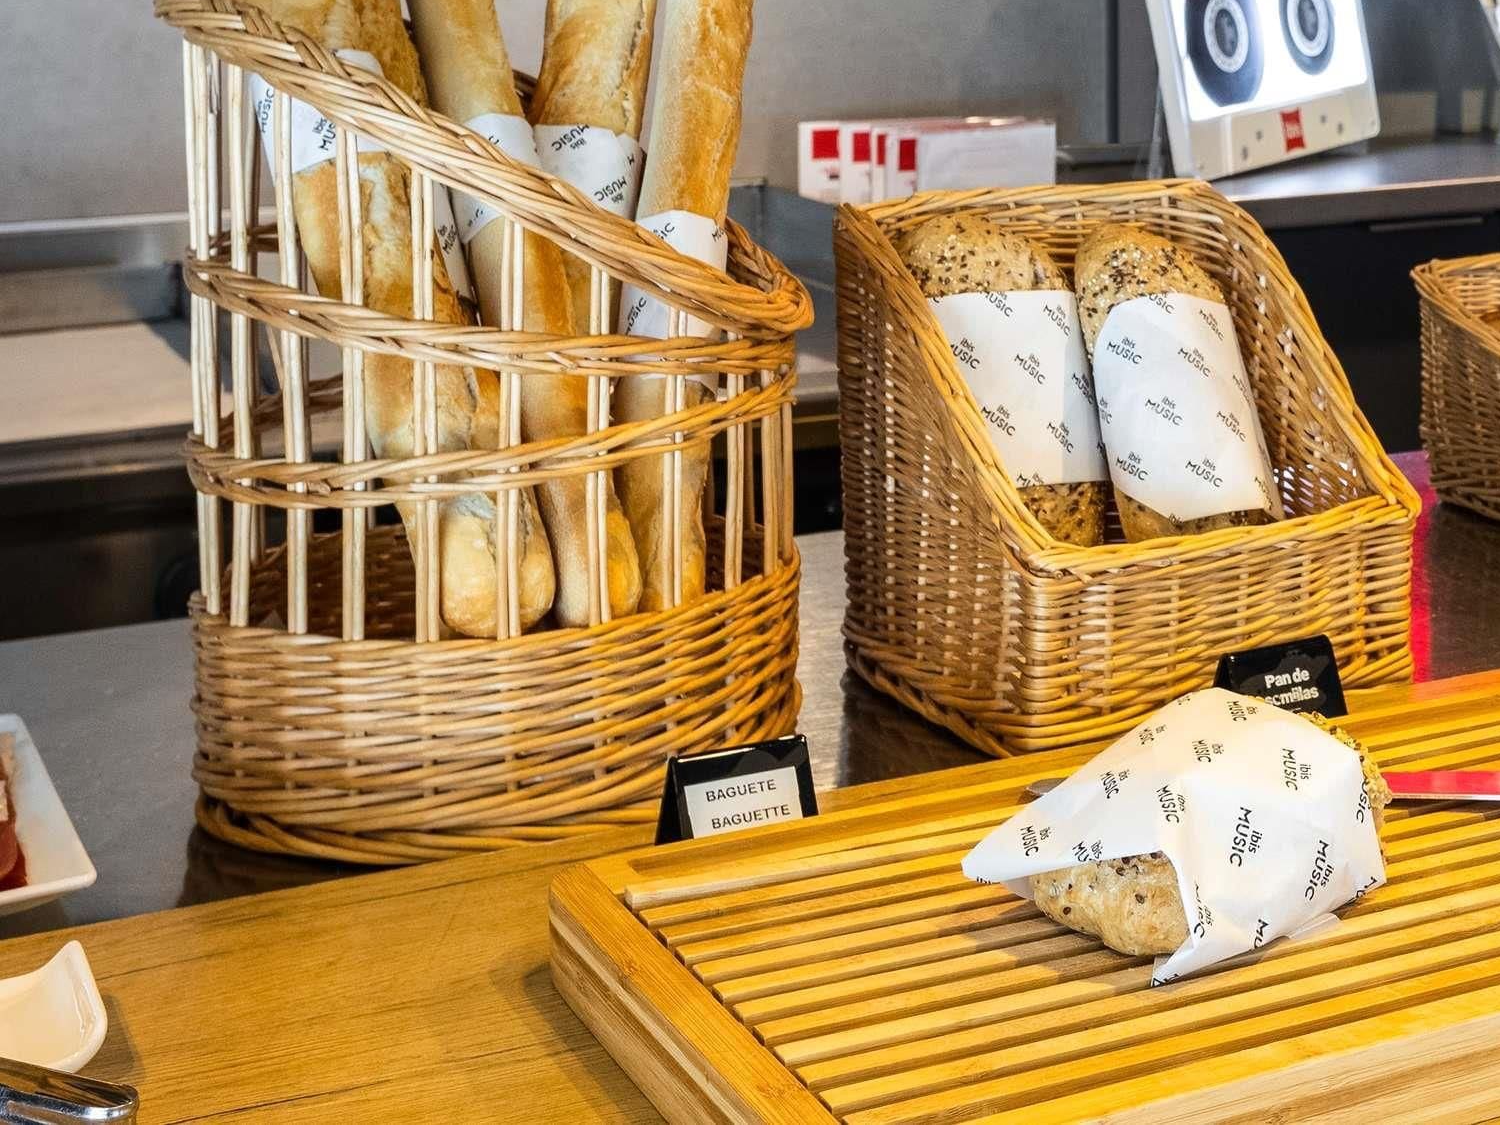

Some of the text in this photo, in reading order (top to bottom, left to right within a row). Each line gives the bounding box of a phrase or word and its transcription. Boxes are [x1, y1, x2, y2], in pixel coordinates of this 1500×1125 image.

[594, 176, 627, 203] MUSIC
[1043, 305, 1071, 337] MUSIC
[960, 337, 976, 353] ibis
[1106, 341, 1143, 365] MUSIC
[1121, 336, 1136, 350] ibis
[1014, 354, 1046, 385] MUSIC
[1178, 347, 1212, 378] MUSIC
[996, 404, 1011, 419] ibis
[1145, 399, 1184, 426] MUSIC
[1162, 395, 1177, 410] ibis
[980, 406, 1016, 436] MUSIC
[1216, 411, 1247, 442] MUSIC
[1046, 422, 1074, 453] MUSIC
[1115, 457, 1149, 481] MUSIC
[1127, 451, 1142, 466] ibis
[1202, 458, 1217, 473] ibis
[1185, 460, 1224, 488] MUSIC
[1264, 667, 1310, 689] Pan de
[1282, 748, 1299, 791] MUSIC
[1300, 763, 1312, 780] ibis
[705, 779, 777, 803] BAGUETE
[1100, 771, 1119, 800] MUSIC
[1156, 785, 1180, 824] MUSIC
[1356, 777, 1369, 824] USIC
[711, 804, 791, 829] BAGUETTE
[1020, 826, 1039, 857] MUSIC
[1229, 806, 1252, 867] MUSIC
[1248, 829, 1263, 854] ibis
[1304, 839, 1329, 901] MUSIC
[1320, 864, 1335, 888] ibis
